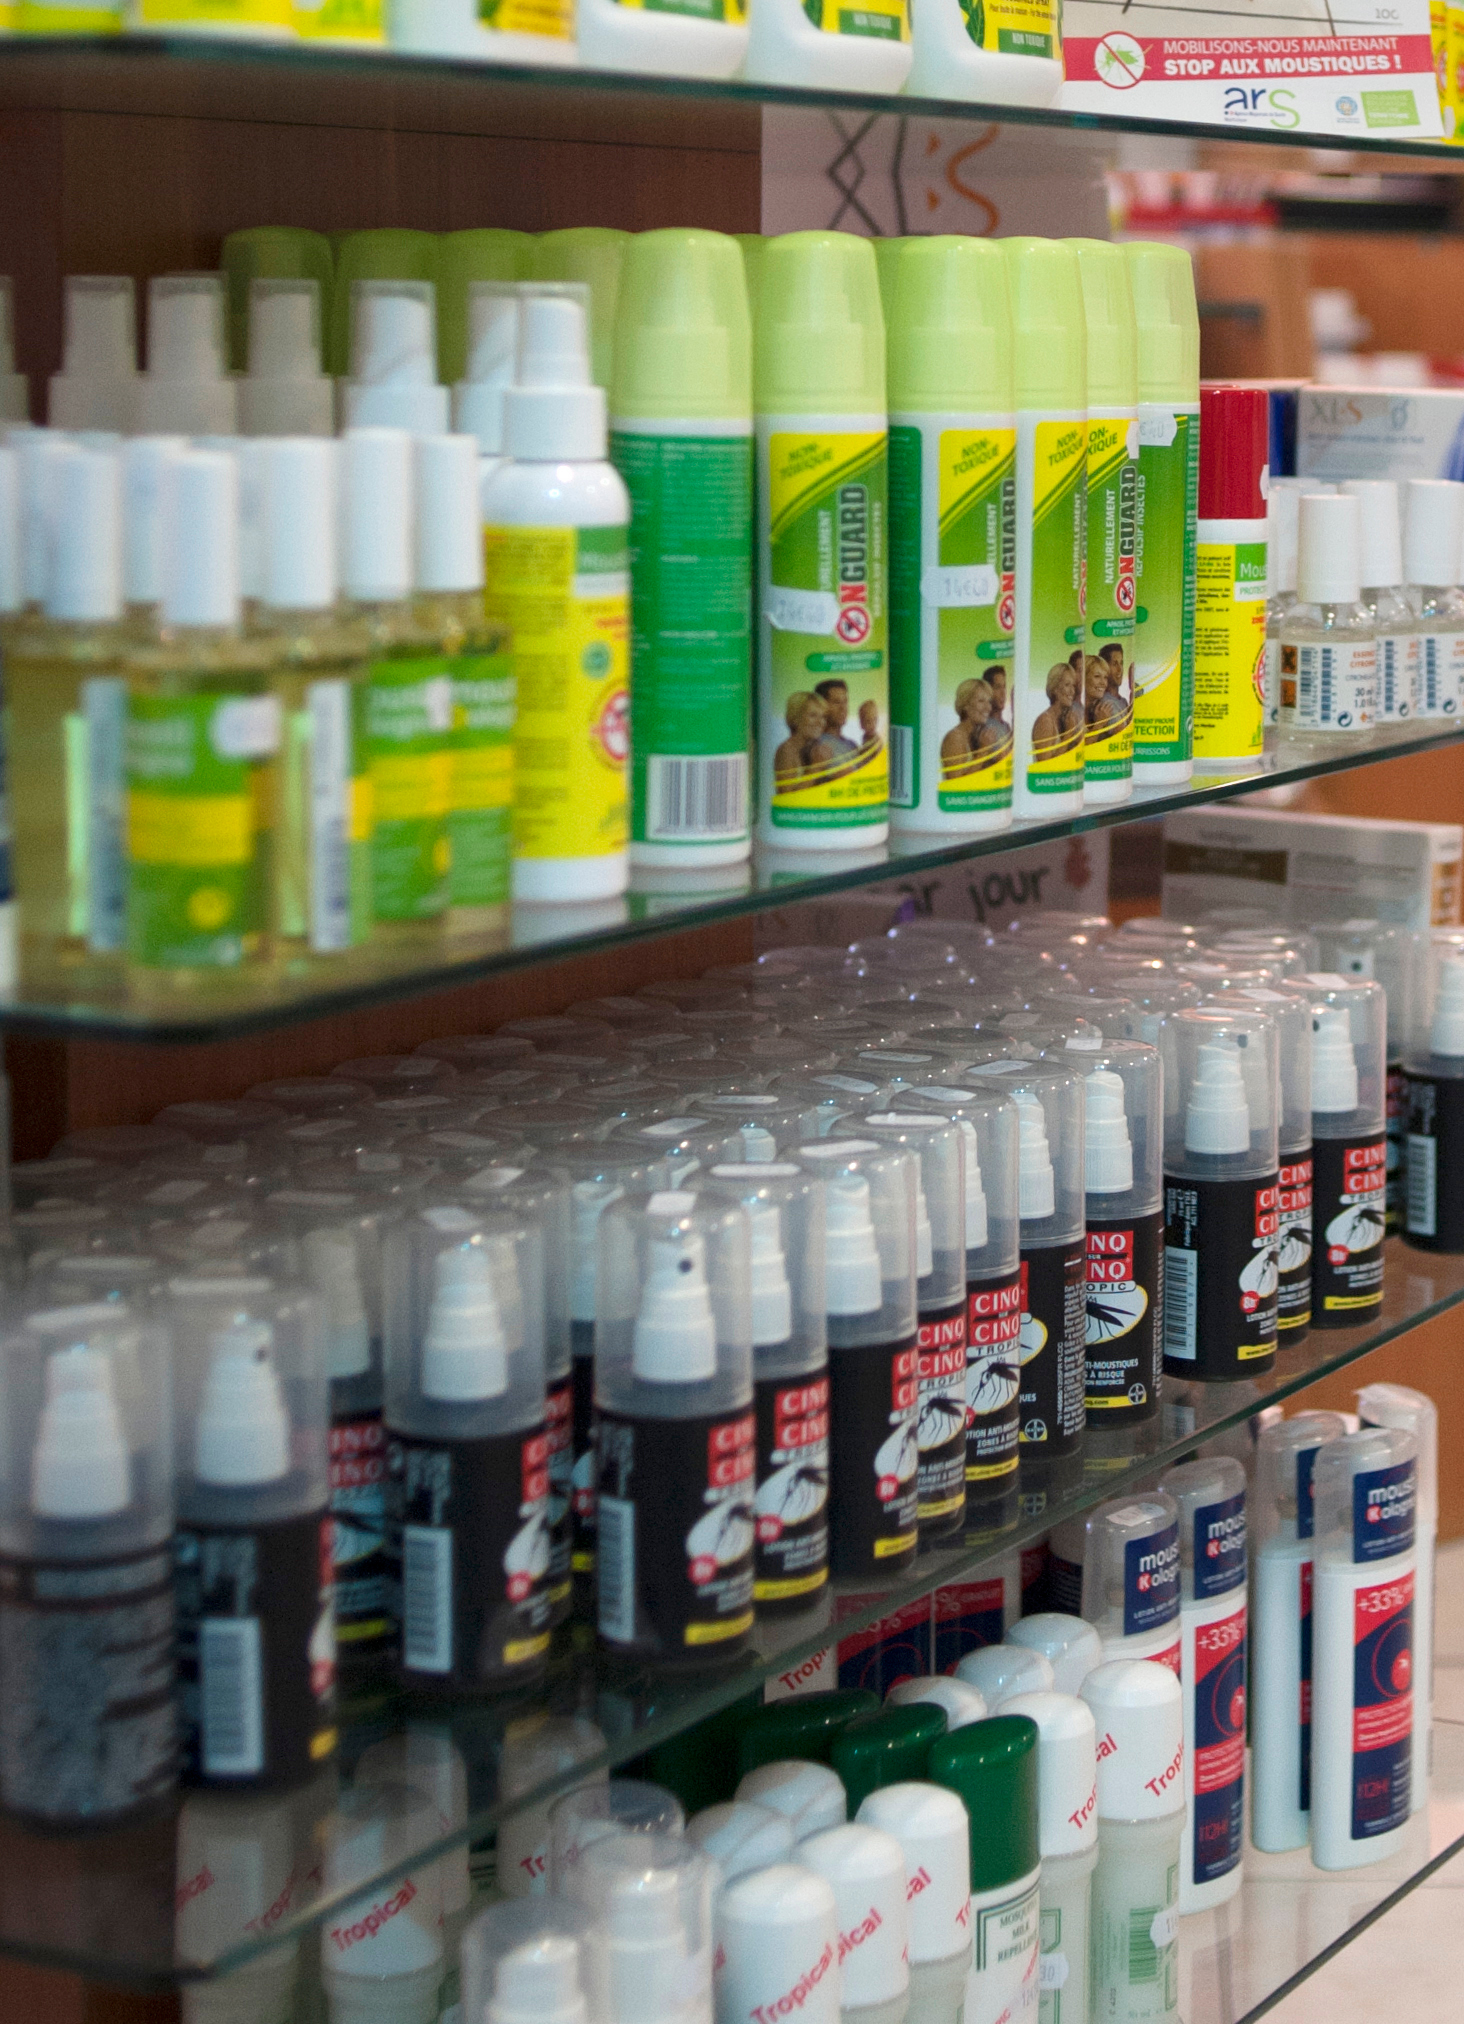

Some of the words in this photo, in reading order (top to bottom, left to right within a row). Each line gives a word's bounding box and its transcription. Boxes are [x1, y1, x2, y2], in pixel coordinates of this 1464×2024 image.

[1163, 39, 1300, 55] MOBILISONS-NOUS
[1302, 37, 1399, 52] MAINTENANT
[1164, 59, 1216, 76] STOP
[1219, 58, 1262, 75] AUX
[1264, 55, 1391, 74] MOUSTIQUES
[1395, 55, 1403, 70] !
[1087, 433, 1118, 456] XIQUE
[1088, 427, 1109, 443] ON-
[1105, 489, 1116, 584] NATURELLEMENT
[1239, 586, 1266, 596] PROTECT
[1134, 725, 1175, 736] TECTION
[1133, 747, 1170, 756] URRISSONS
[966, 865, 1051, 923] jour
[1091, 1234, 1126, 1252] NQ
[1091, 1261, 1126, 1280] NQ
[1086, 1282, 1128, 1293] OPIC
[1085, 1357, 1139, 1370] TI-MOUSTIQUES
[1098, 1369, 1126, 1380] RISQUE
[781, 1387, 824, 1416] CIN
[781, 1419, 824, 1448] CIN
[966, 1429, 986, 1440] OTION
[1368, 1477, 1415, 1505] mous
[1208, 1511, 1246, 1539] mous
[1139, 1541, 1180, 1572] mous
[1137, 1563, 1180, 1592] Kolog
[1357, 1587, 1404, 1613] +33%
[1198, 1622, 1241, 1650] +33%
[779, 1646, 831, 1691] Tropi
[1145, 1738, 1184, 1797] Tropi
[1069, 1784, 1097, 1830] Trop
[330, 1878, 417, 1951] Tropical
[838, 1906, 883, 1966] ical
[749, 1941, 833, 2024] Tropical
